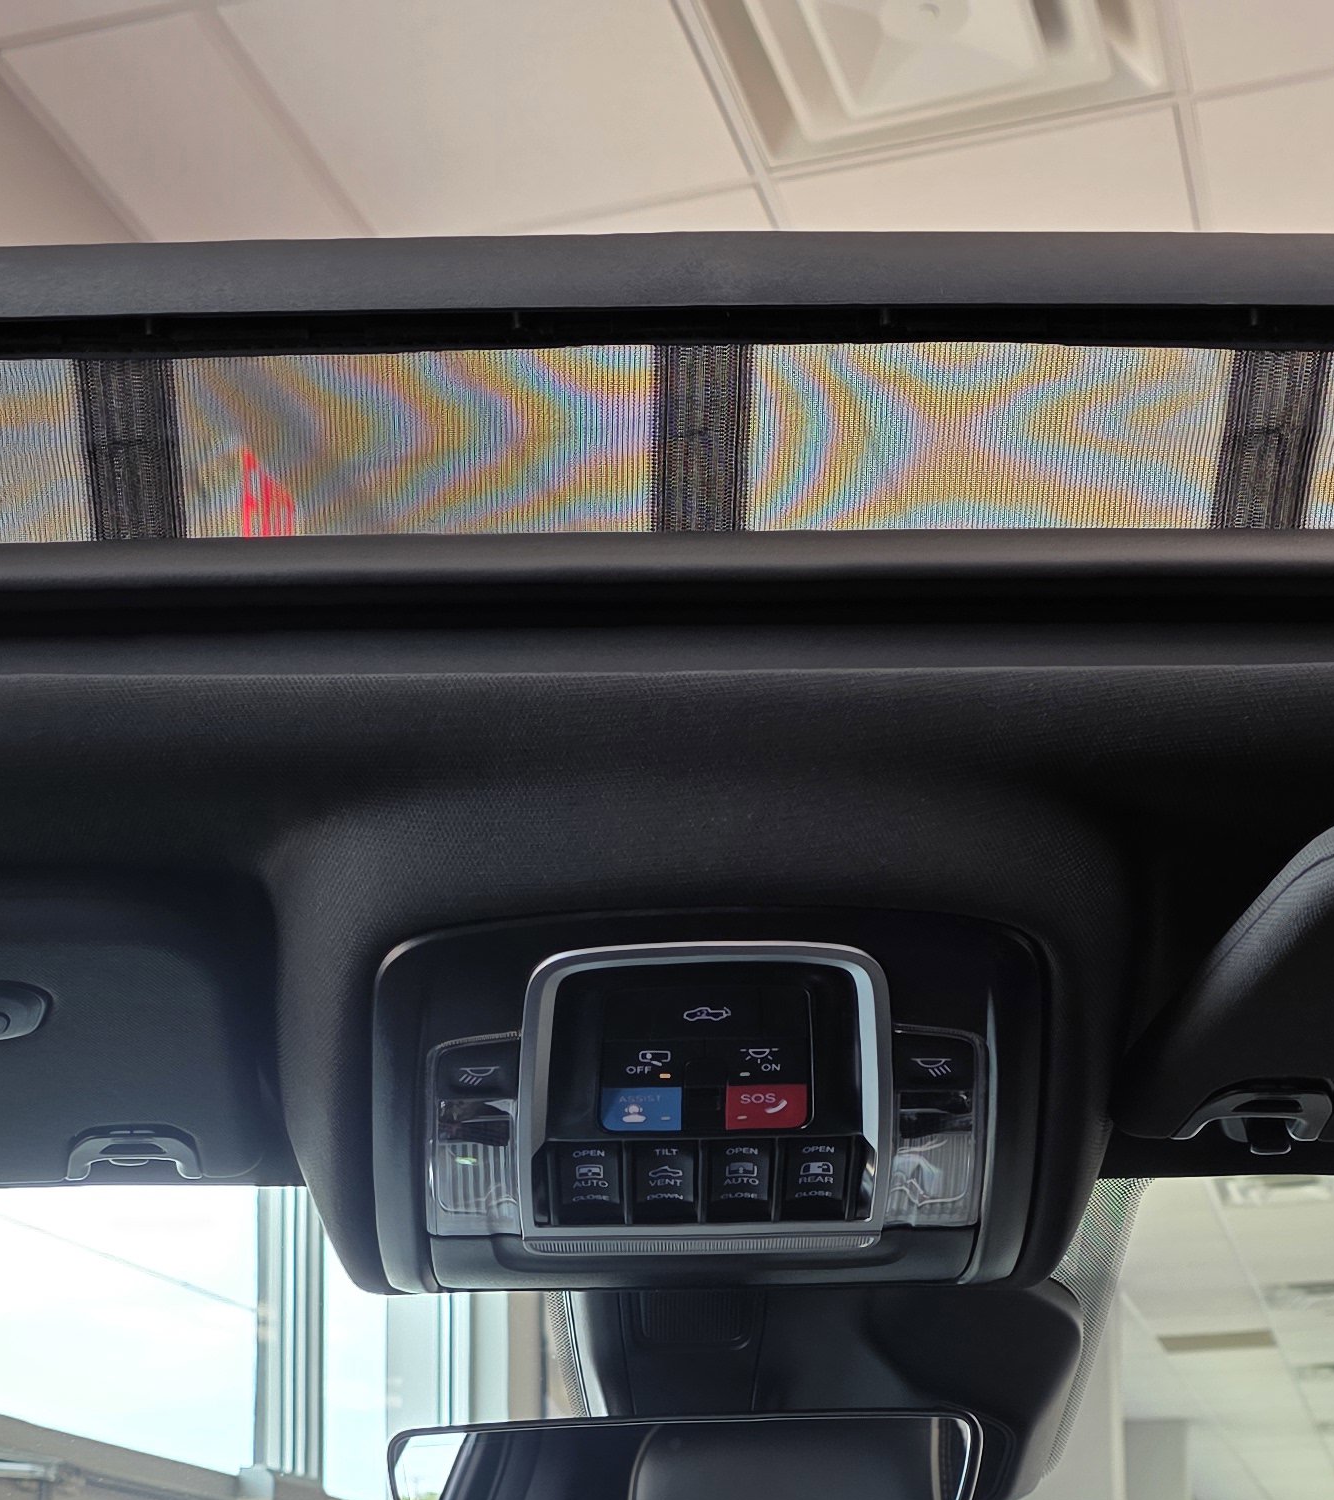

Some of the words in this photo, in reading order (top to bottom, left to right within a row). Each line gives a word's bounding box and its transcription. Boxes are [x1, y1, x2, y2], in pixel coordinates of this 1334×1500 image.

[626, 1066, 652, 1074] OFF
[619, 1094, 661, 1103] ASSIST
[740, 1093, 776, 1104] SOS
[572, 1149, 605, 1157] OPEN
[654, 1148, 679, 1156] TILT
[726, 1147, 758, 1155] OPEN
[802, 1145, 835, 1153] OPEN
[572, 1180, 609, 1188] AUTO
[649, 1179, 683, 1187] VENT
[724, 1177, 759, 1185] AUTO
[799, 1176, 833, 1184] REAR
